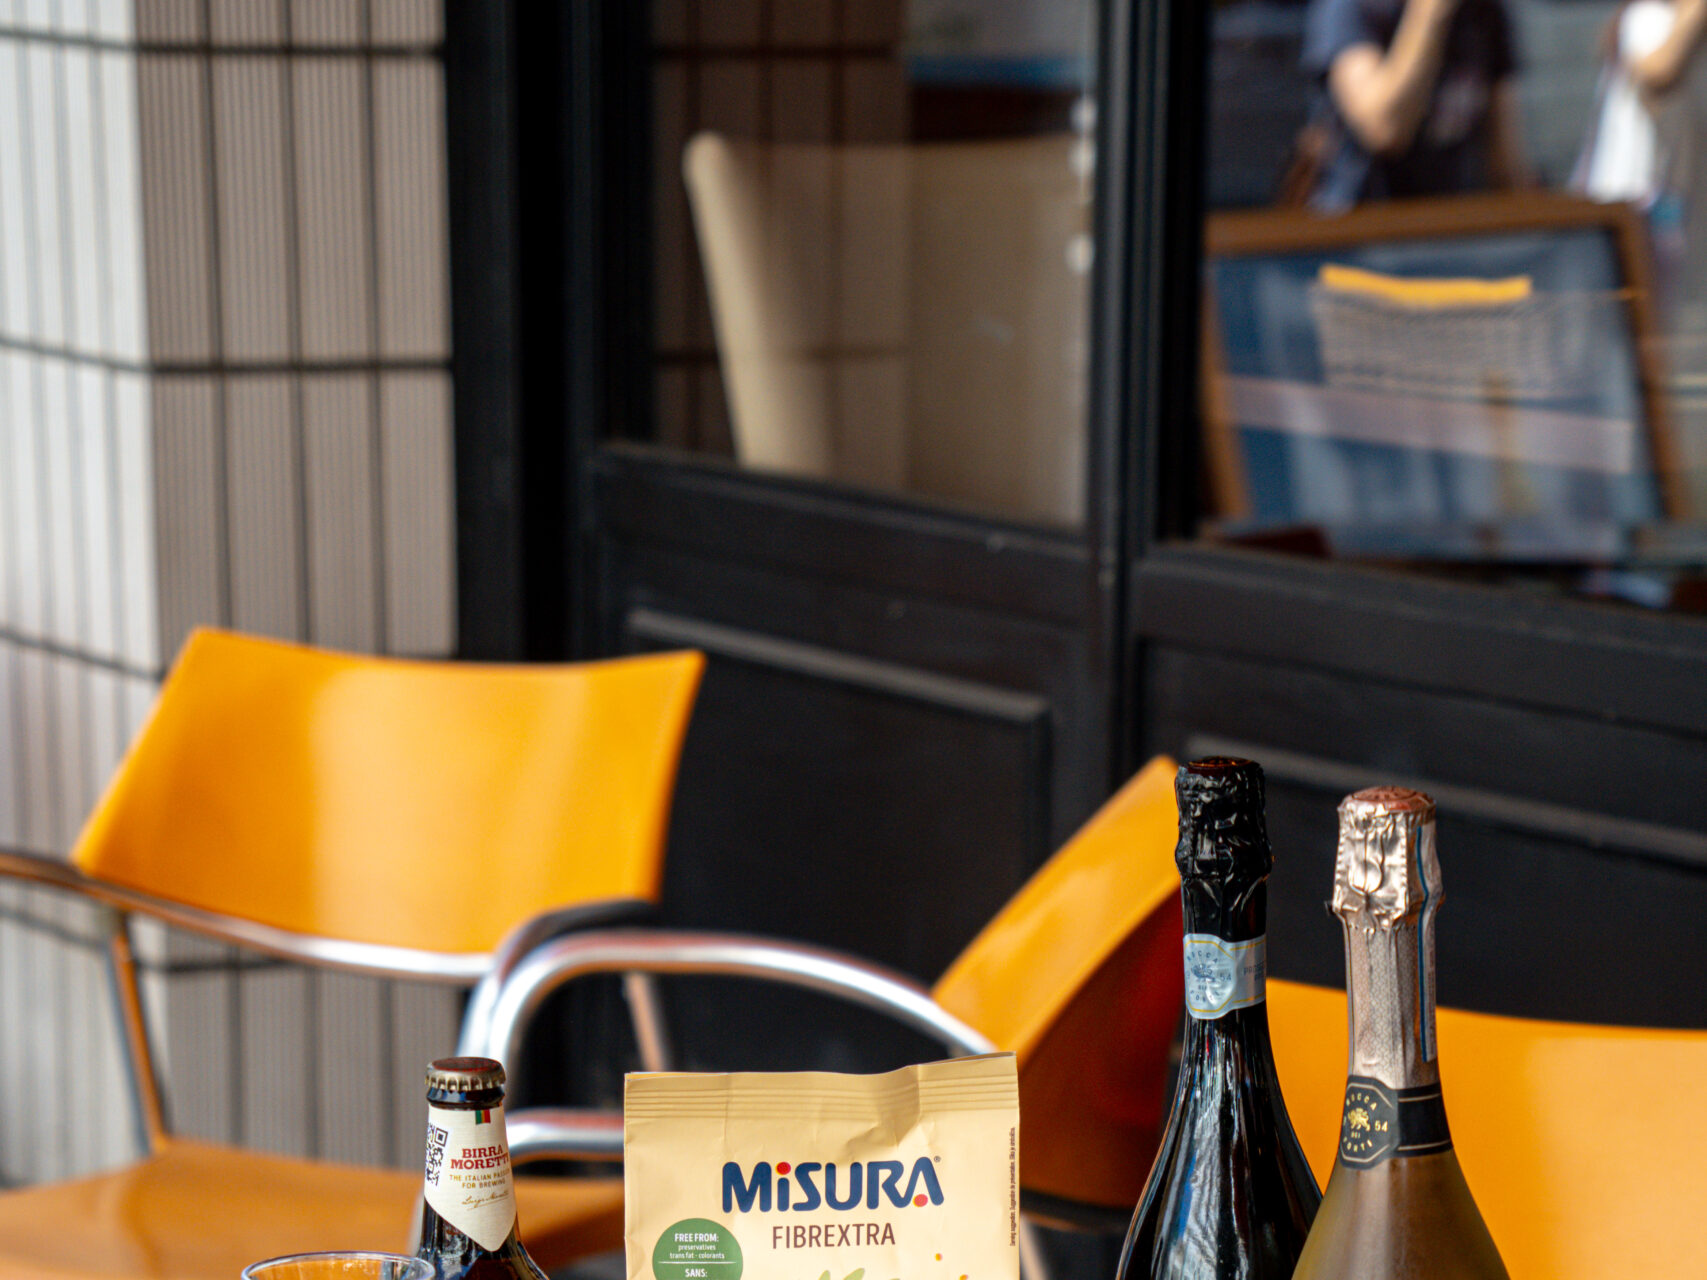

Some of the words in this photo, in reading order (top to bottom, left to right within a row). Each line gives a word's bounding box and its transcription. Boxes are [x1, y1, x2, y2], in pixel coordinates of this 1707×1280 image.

[1374, 1120, 1388, 1132] 54
[462, 1144, 504, 1158] BIRRA
[450, 1152, 509, 1170] MORETTI
[464, 1173, 492, 1181] ITALIAN
[674, 1232, 694, 1243] FREE
[694, 1232, 720, 1243] FROM:
[772, 1222, 896, 1250] FIBREXTRA
[678, 1244, 716, 1252] preservatives
[669, 1252, 685, 1260] trans
[685, 1251, 694, 1259] fat
[698, 1251, 725, 1260] colorants
[684, 1268, 708, 1278] SANS:
